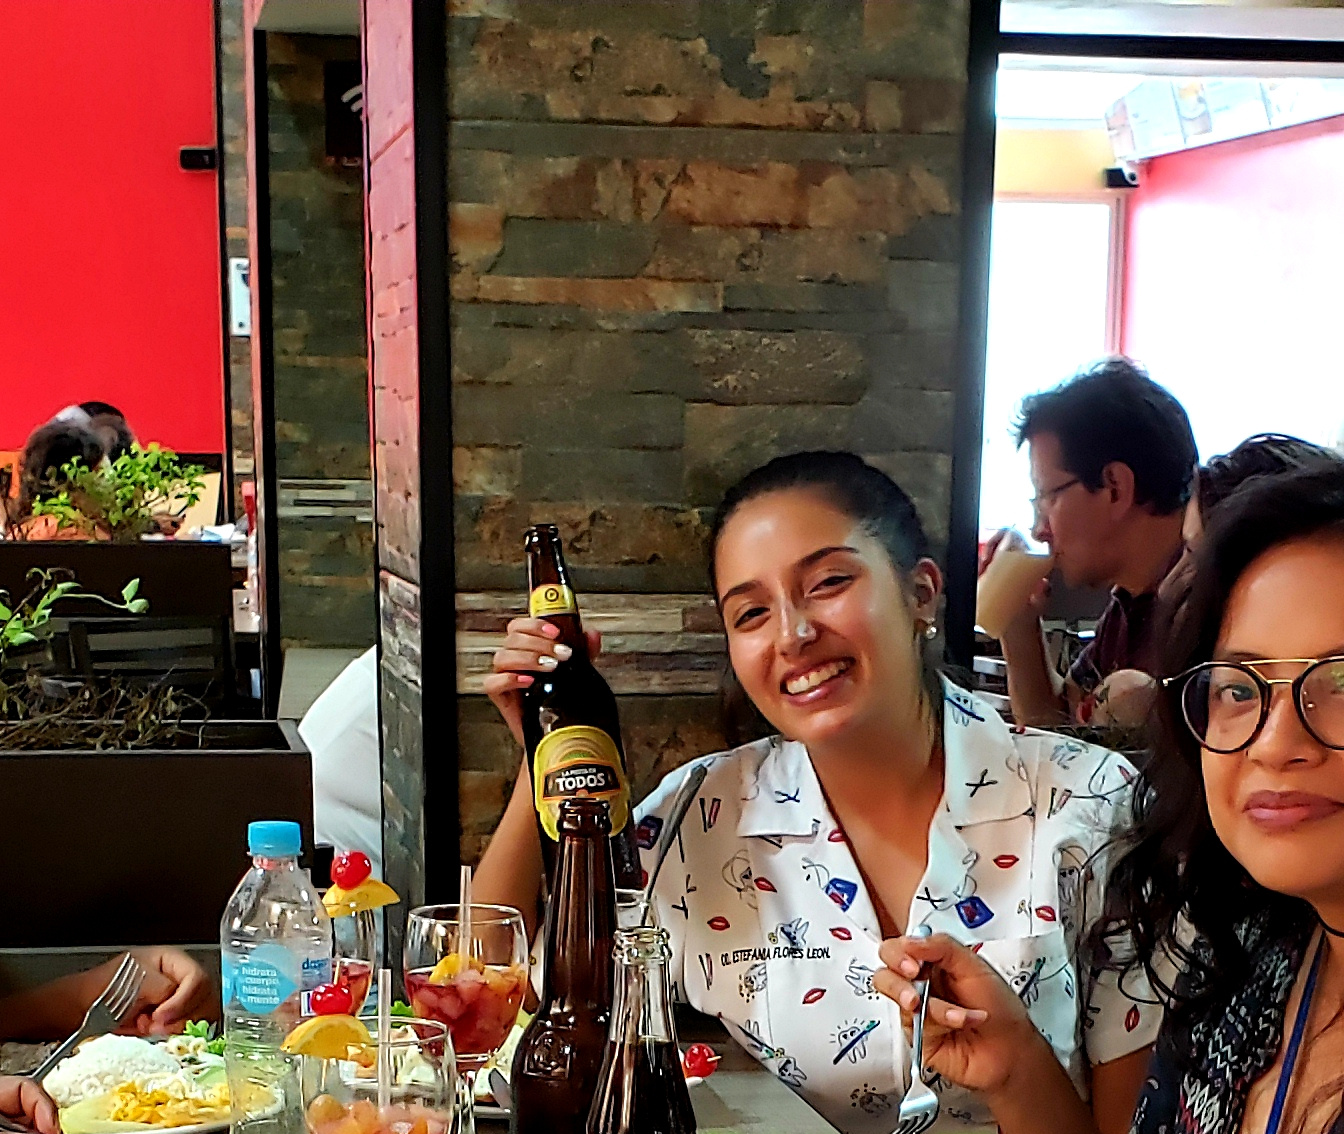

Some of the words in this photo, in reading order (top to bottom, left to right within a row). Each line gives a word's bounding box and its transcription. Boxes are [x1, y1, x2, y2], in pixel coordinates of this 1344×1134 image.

[555, 772, 606, 792] TODOS
[772, 946, 804, 959] FLORES
[242, 967, 277, 977] hidrata
[242, 985, 277, 995] hidrata
